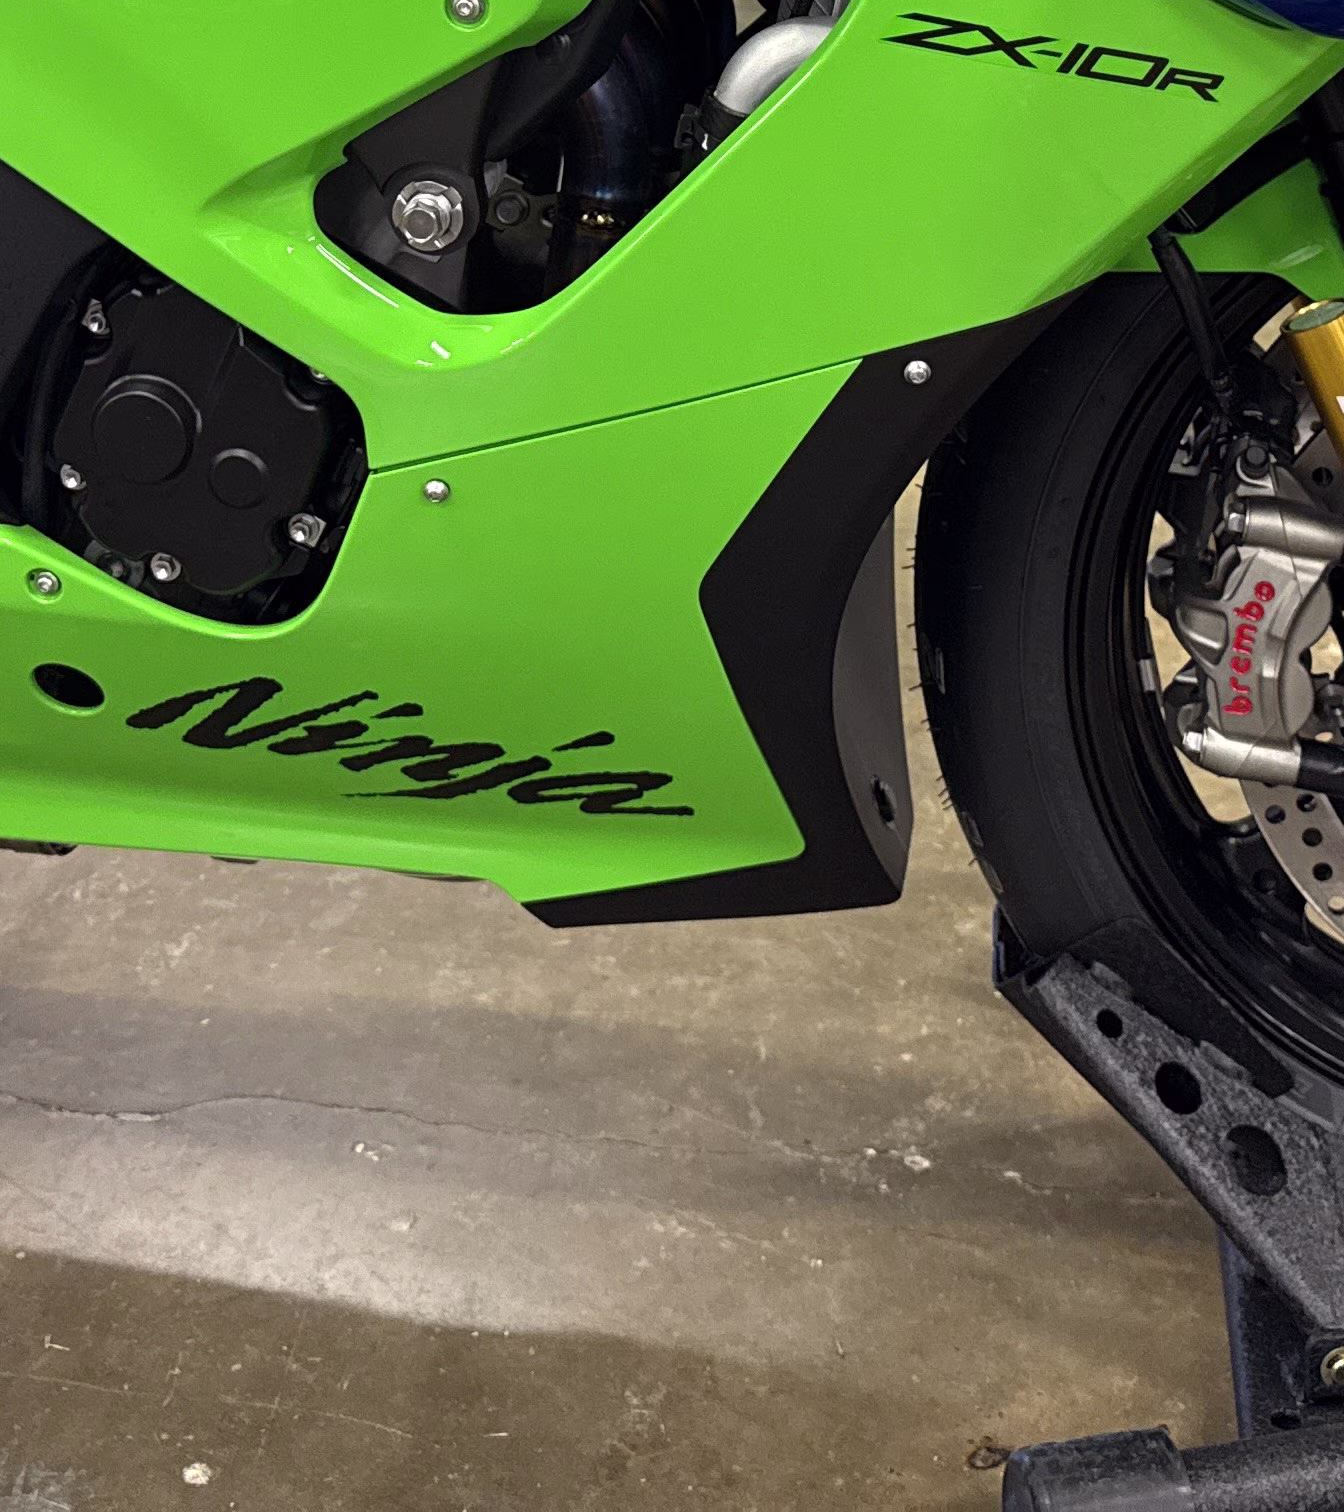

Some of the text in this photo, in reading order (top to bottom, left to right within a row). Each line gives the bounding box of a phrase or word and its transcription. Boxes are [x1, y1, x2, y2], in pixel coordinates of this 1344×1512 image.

[882, 12, 1225, 103] ZX-10R
[1222, 580, 1275, 716] brembo
[126, 677, 694, 816] Ninja
